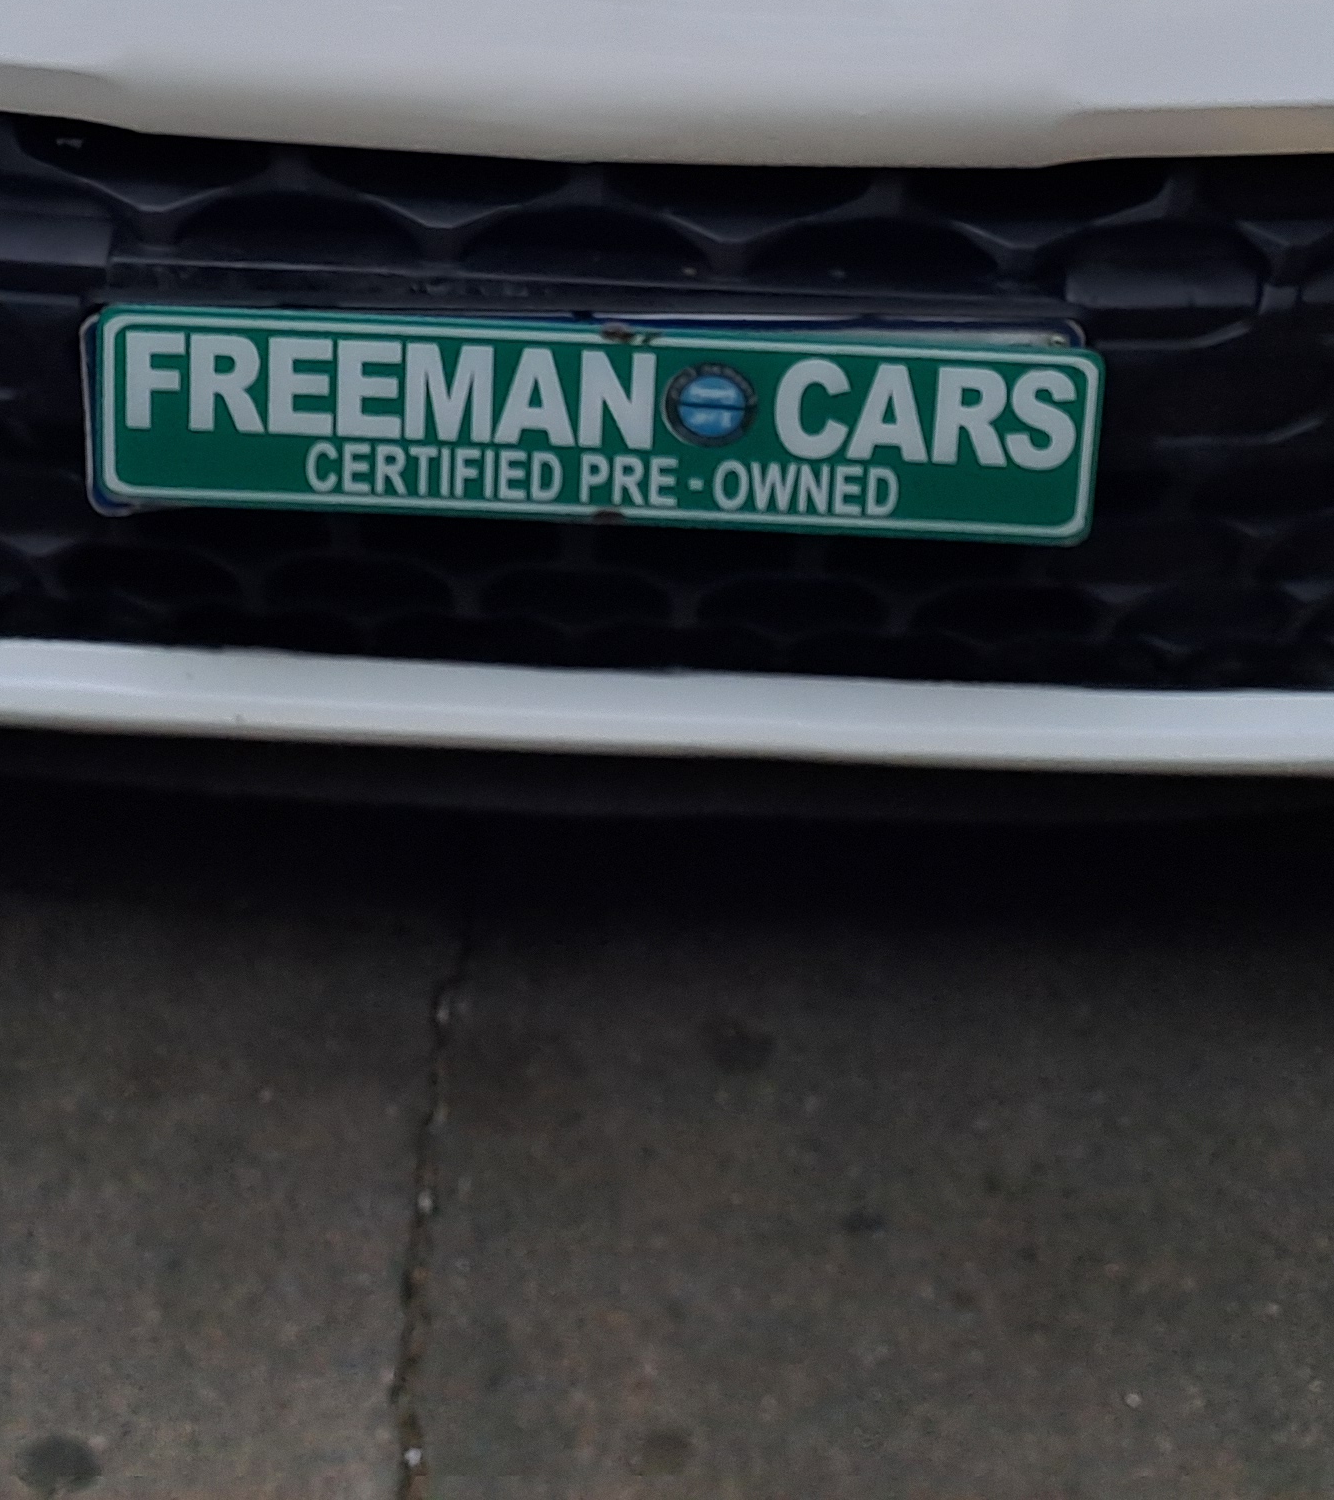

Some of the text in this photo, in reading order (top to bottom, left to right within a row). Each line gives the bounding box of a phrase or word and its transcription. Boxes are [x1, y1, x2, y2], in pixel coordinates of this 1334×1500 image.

[124, 329, 657, 451] FREEMAN
[774, 357, 1078, 472] CARS
[304, 441, 564, 502] CERTIFIED
